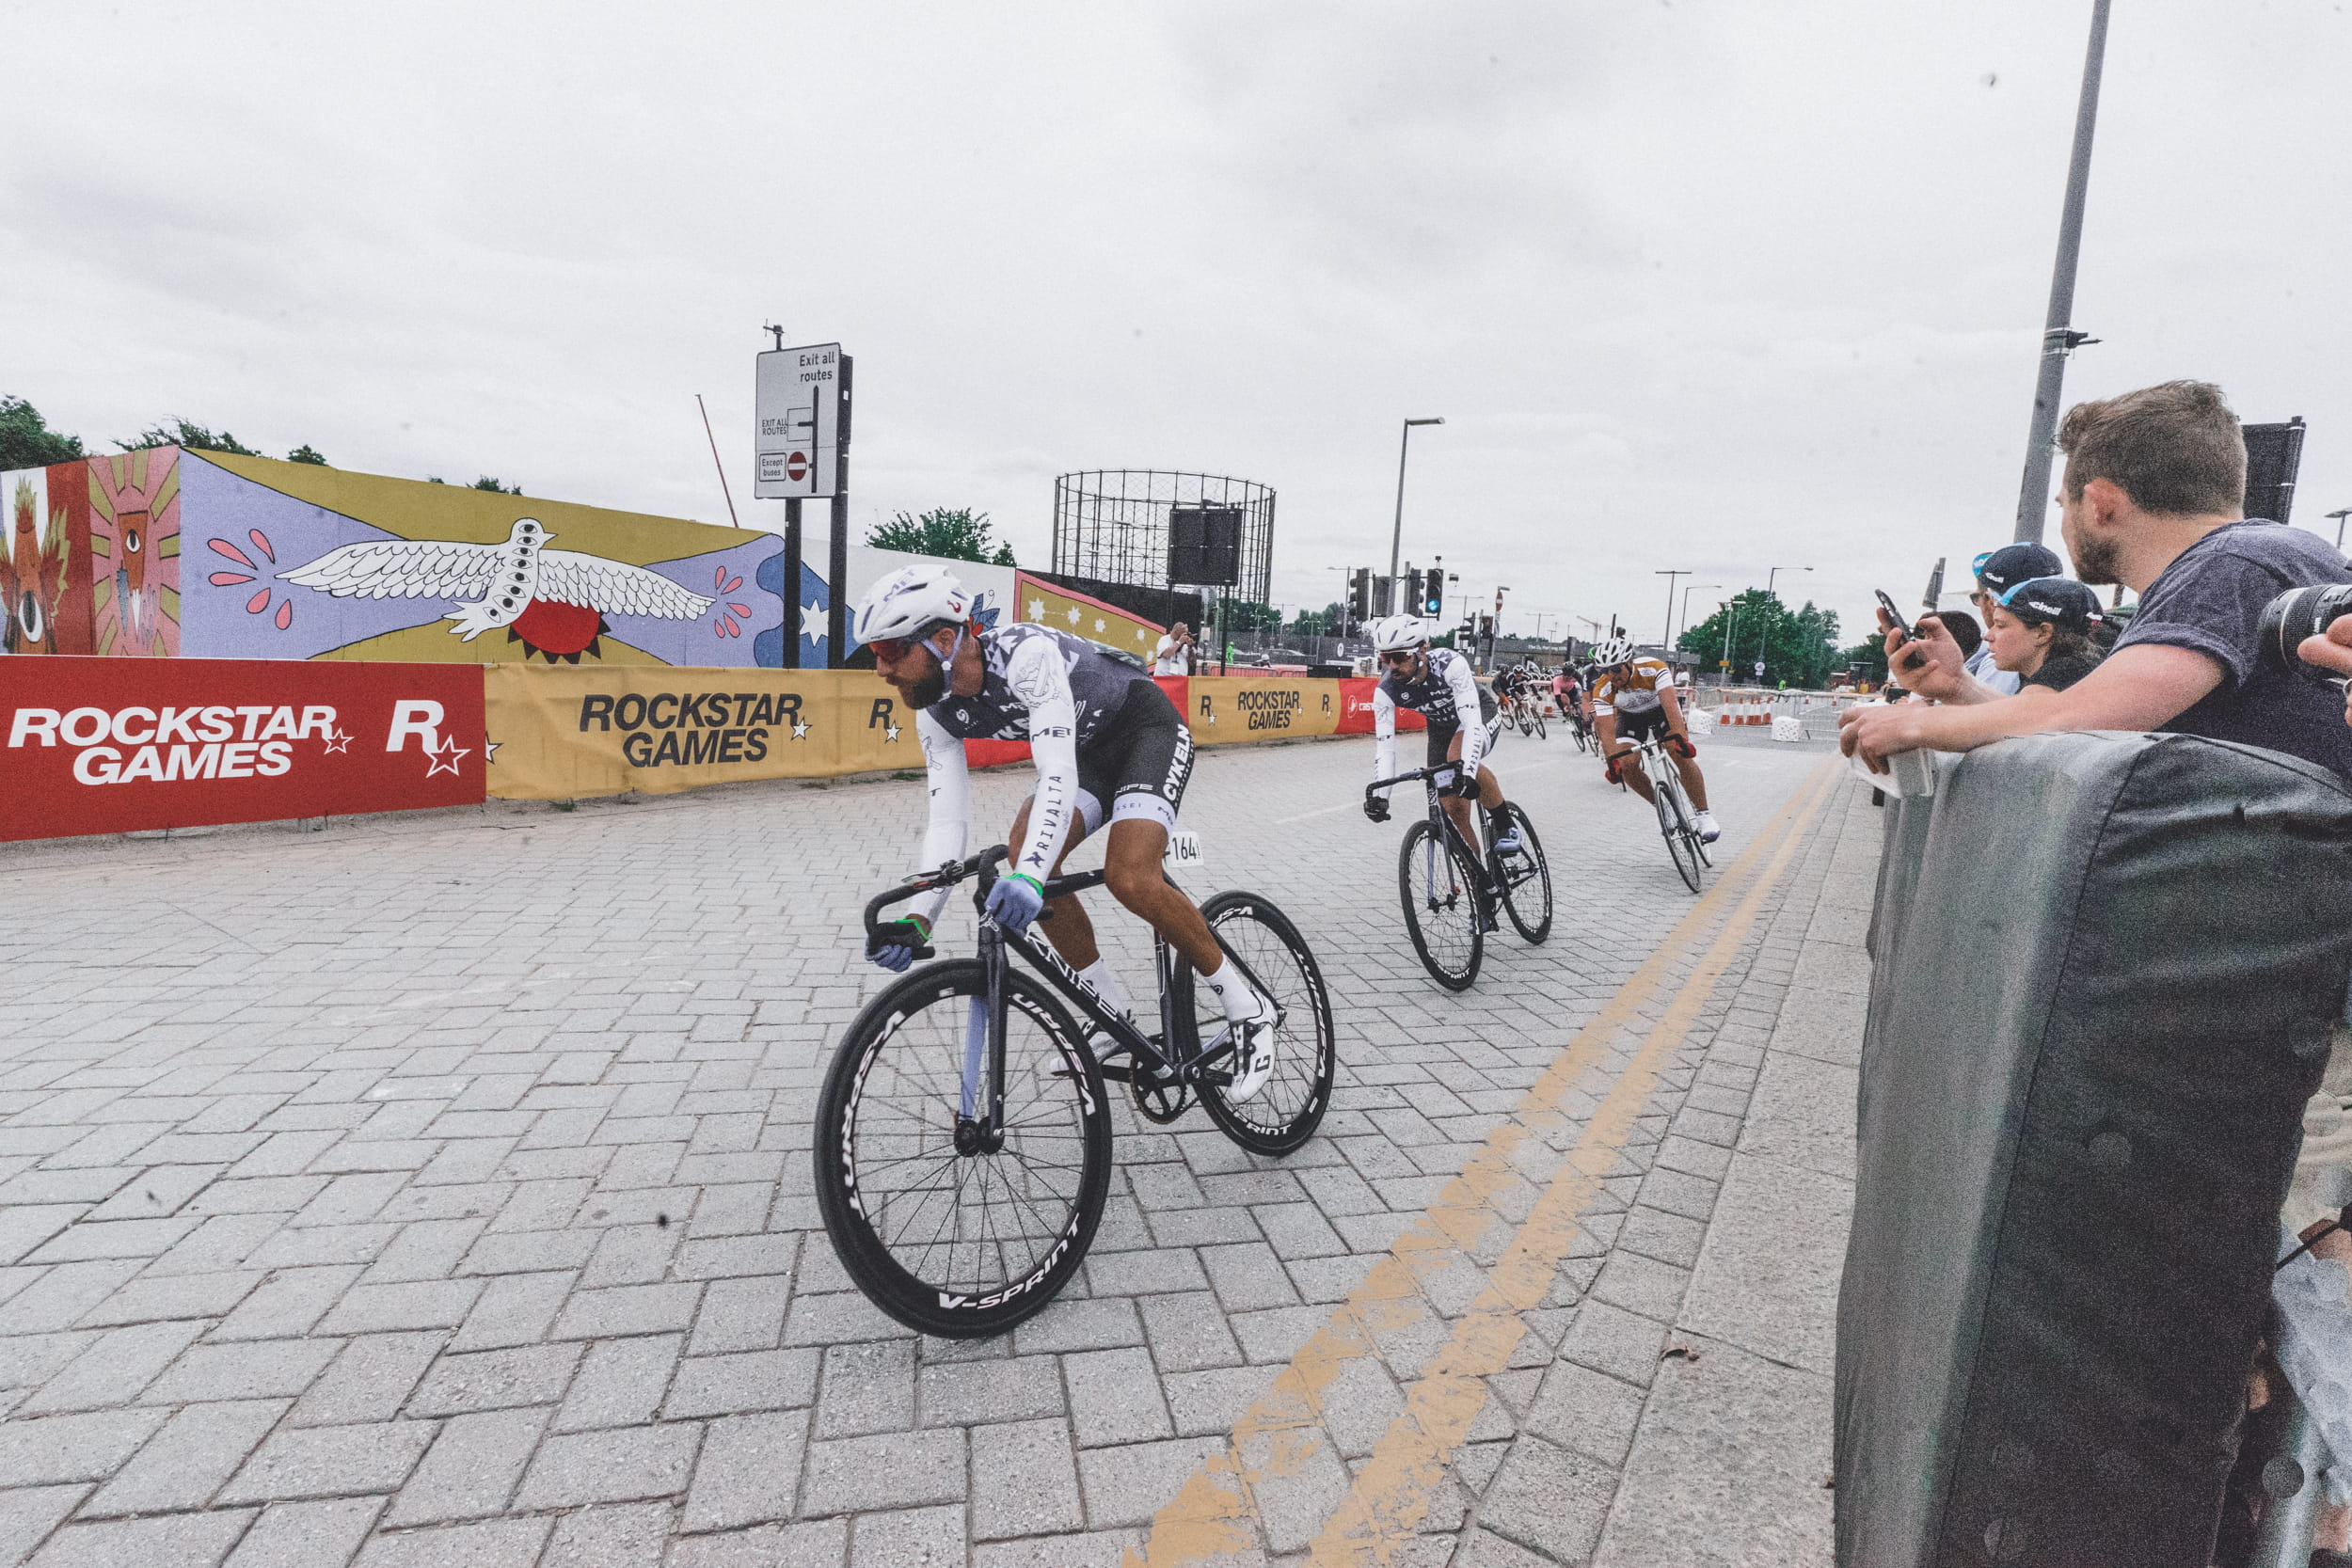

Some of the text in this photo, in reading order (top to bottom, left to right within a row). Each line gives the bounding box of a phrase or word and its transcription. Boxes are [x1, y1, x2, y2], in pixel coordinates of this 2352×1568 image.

[800, 351, 834, 367] Exit all
[801, 370, 833, 382] routes
[762, 419, 775, 427] EXIT
[762, 427, 787, 436] ROUTES
[762, 459, 783, 467] Except
[580, 693, 803, 732] ROCKSTAR
[1238, 691, 1299, 711] ROCKSTAR
[8, 705, 337, 748] ROCKSTAR
[1248, 710, 1291, 730] GAMES
[72, 741, 293, 785] GAMES
[623, 729, 769, 768] GAMES
[1163, 723, 1190, 800] CYKELN
[1037, 775, 1062, 850] RIVALTA
[938, 1212, 1080, 1310] V-SPRINT
